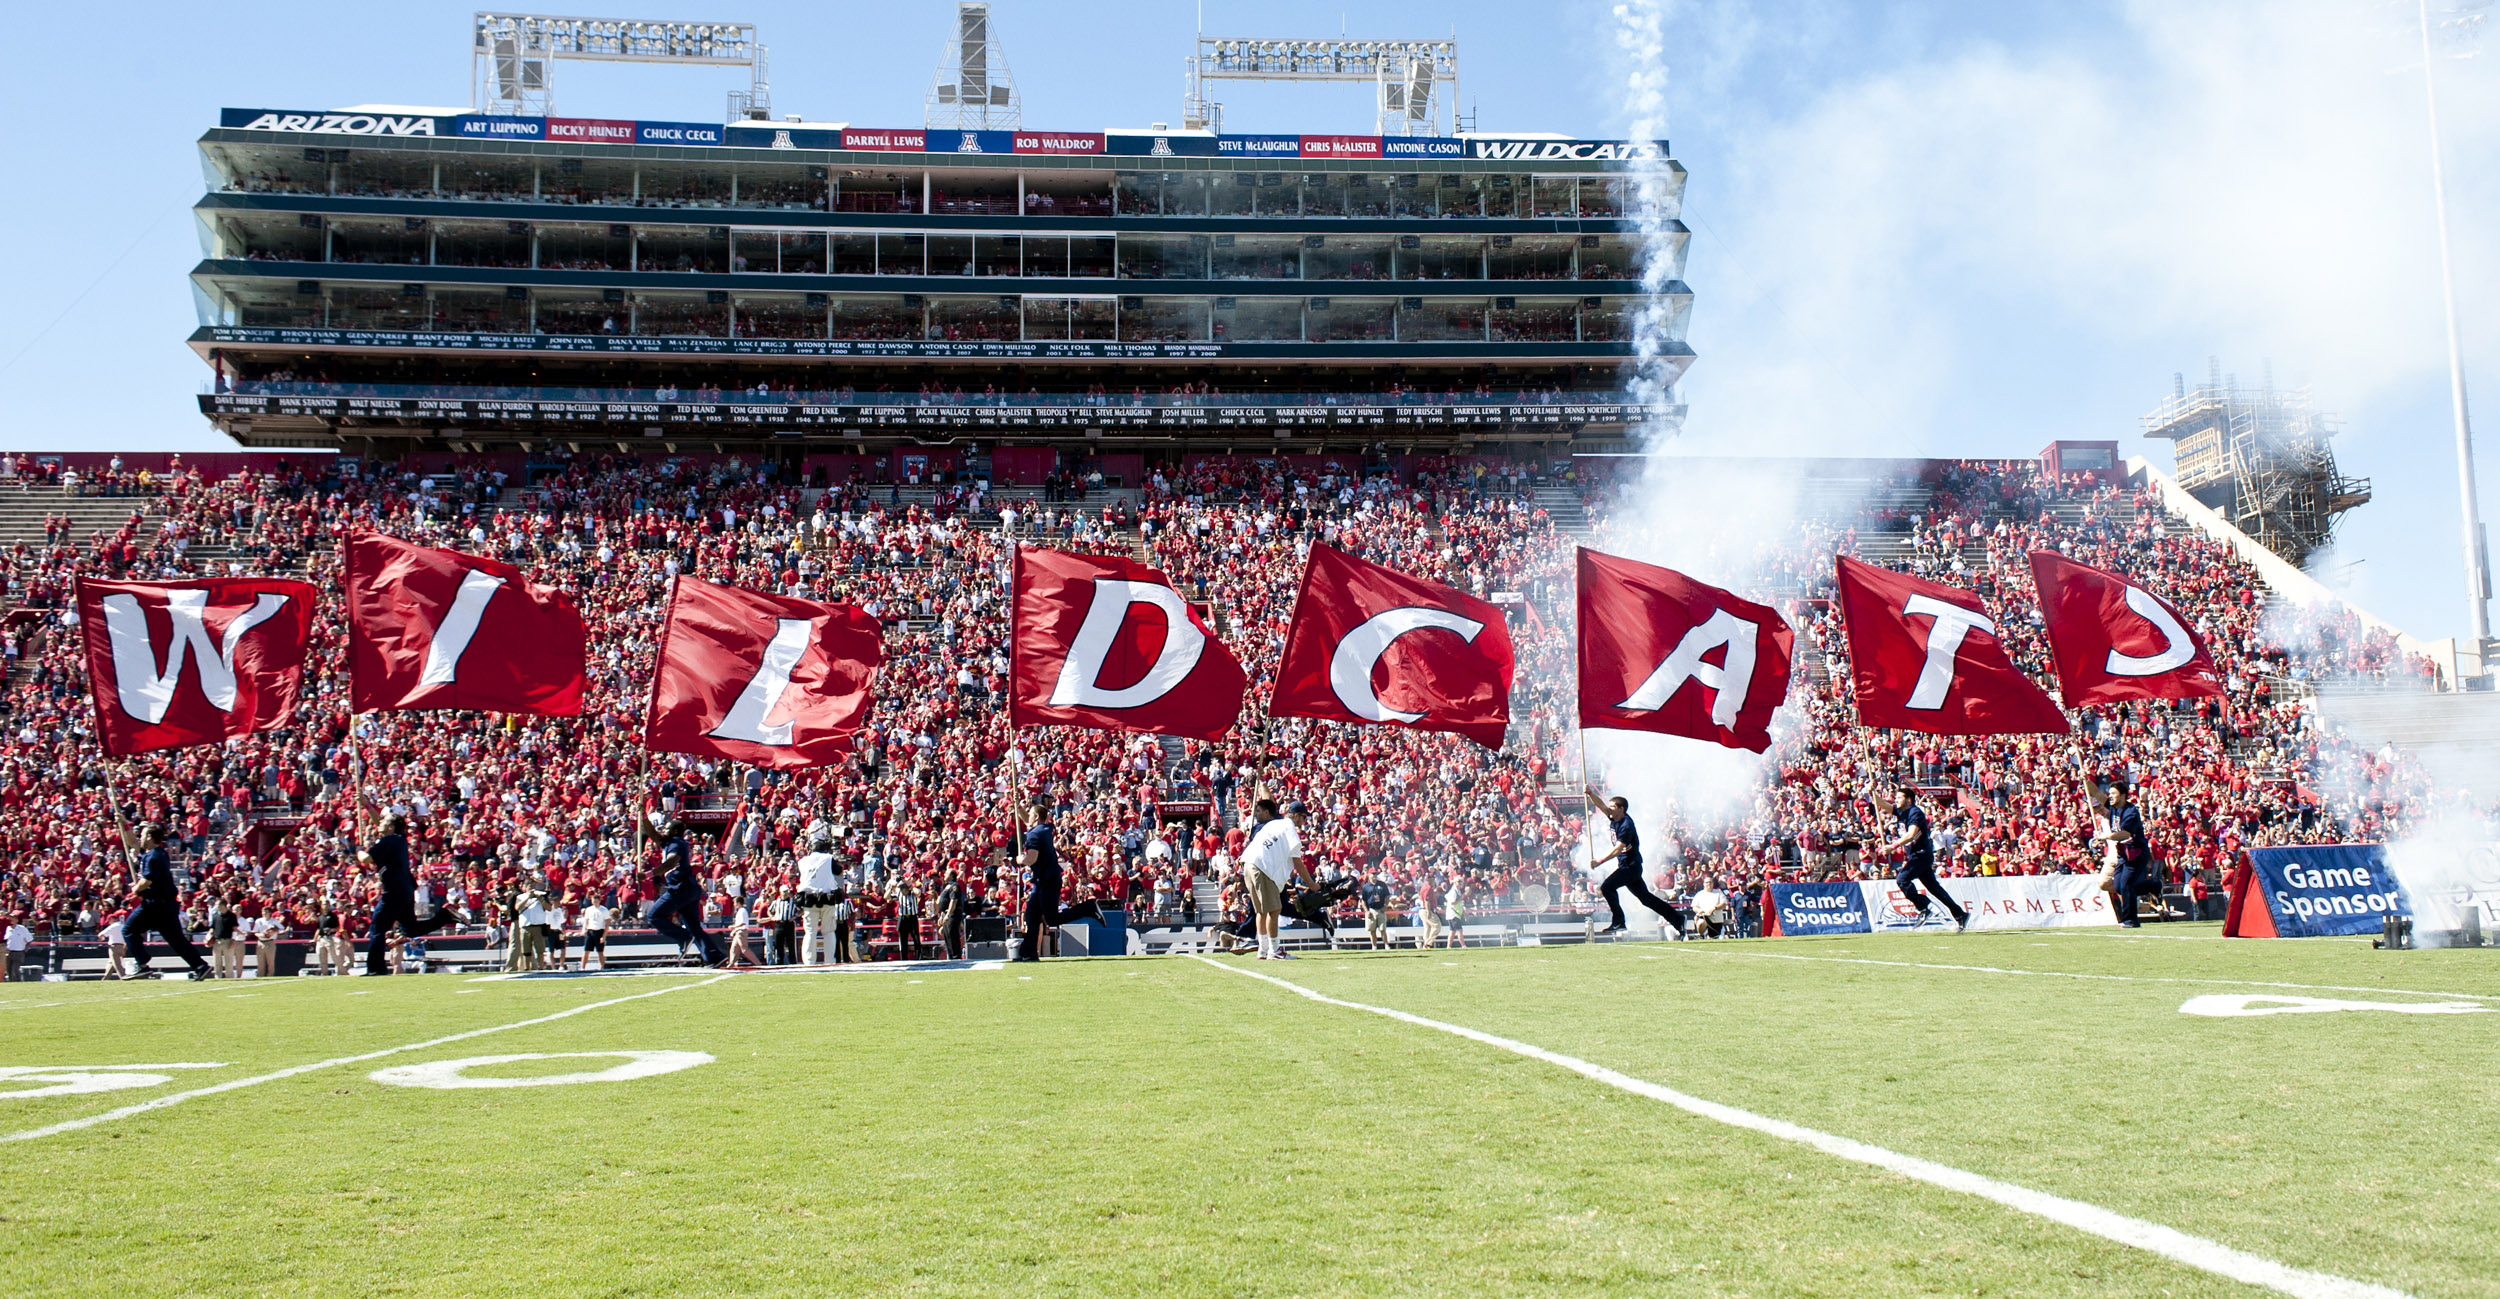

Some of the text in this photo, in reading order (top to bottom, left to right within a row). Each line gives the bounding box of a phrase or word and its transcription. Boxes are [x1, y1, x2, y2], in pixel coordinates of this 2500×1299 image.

[245, 114, 436, 134] ARIZONA
[463, 121, 539, 135] ART LUPPINO
[551, 124, 631, 138] RICKY HUNLEY
[643, 127, 717, 142] CHUCK CECIL
[846, 135, 924, 148] DARRYLL LEWIS
[1016, 137, 1095, 150] ROB WALDROP
[1218, 140, 1298, 152] STEVE McLAUGHLIN
[1304, 142, 1377, 153] CHRIS McALISTER
[1386, 143, 1460, 154] ANTOINE CASON
[1476, 142, 1659, 159] WILDCATS
[347, 332, 407, 340] GLENN PARKER
[215, 397, 267, 405] DAVE HIBBERT
[279, 398, 337, 407] HANK STANTON
[350, 400, 400, 408] WALT NIELSEN
[419, 401, 437, 409] TONY
[478, 402, 532, 410] ALLAN DURDEN
[730, 406, 788, 414] TOM GREENFIELD
[916, 408, 970, 416] JACKIE WALLACE
[1162, 409, 1204, 417] JOSH MILLER
[1337, 408, 1383, 416] RICKY HUNLEY
[1510, 407, 1559, 415] JOE TOFFLEMIRE
[419, 568, 506, 686] I
[1050, 578, 1206, 709] D
[103, 588, 291, 724] W
[1903, 593, 1995, 710] T
[1329, 607, 1486, 723] C
[1613, 606, 1759, 732] A
[708, 618, 812, 747] L
[2283, 863, 2371, 889] Game
[1791, 892, 1847, 910] Game
[1964, 895, 2104, 915] FARMERS
[2276, 891, 2399, 922] Sponsor
[1783, 908, 1862, 928] Sponsor
